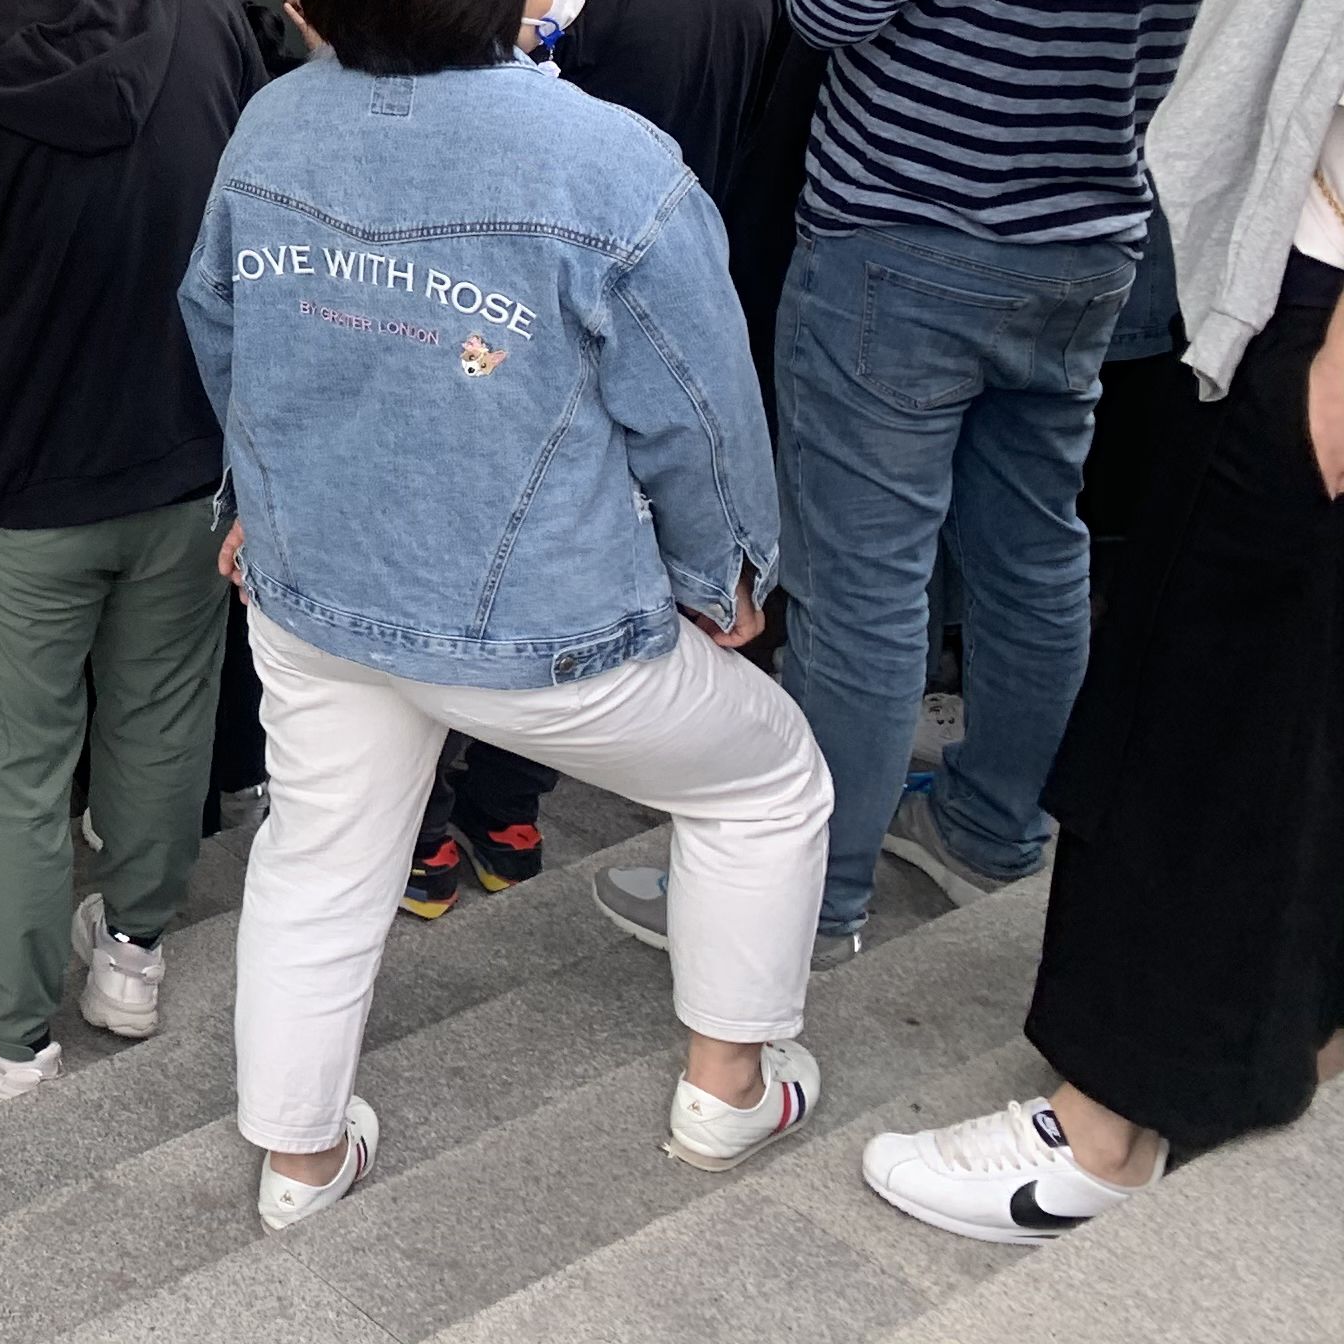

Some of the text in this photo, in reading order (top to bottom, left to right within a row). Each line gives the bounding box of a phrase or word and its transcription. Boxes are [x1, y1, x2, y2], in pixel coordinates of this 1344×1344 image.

[232, 245, 538, 342] OVE WITH ROSE
[299, 300, 317, 315] BY
